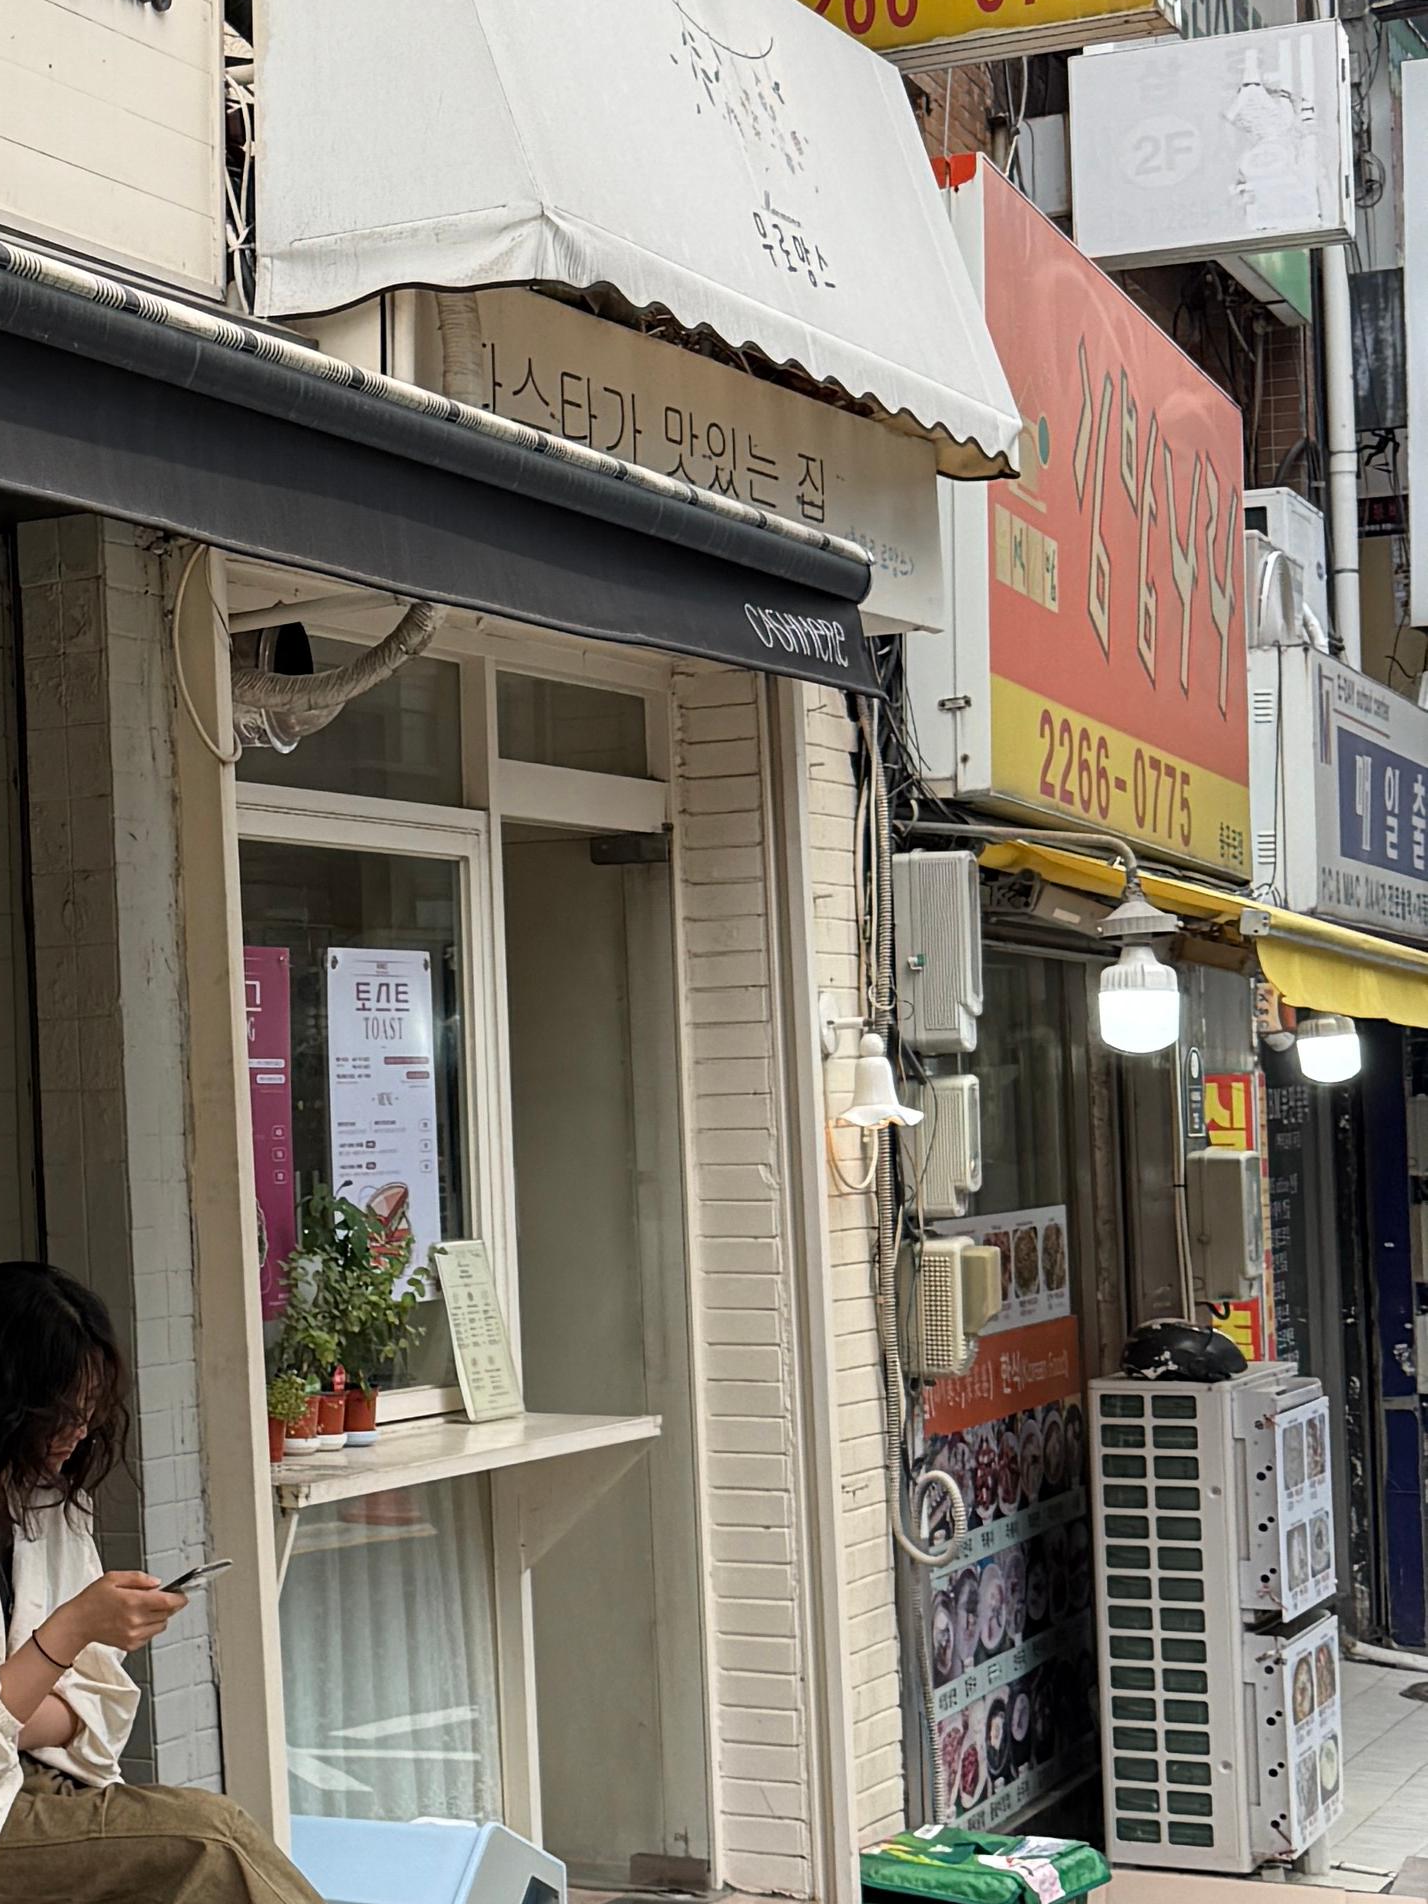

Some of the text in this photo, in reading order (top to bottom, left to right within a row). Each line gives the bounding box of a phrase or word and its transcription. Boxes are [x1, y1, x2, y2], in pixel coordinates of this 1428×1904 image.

[663, 399, 779, 509] 맛있는
[796, 452, 825, 524] 집
[1072, 334, 1239, 723] 김밥나라
[1038, 708, 1192, 849] 2266-0775
[355, 981, 411, 1013] 토스트
[364, 1016, 405, 1041] TOAST
